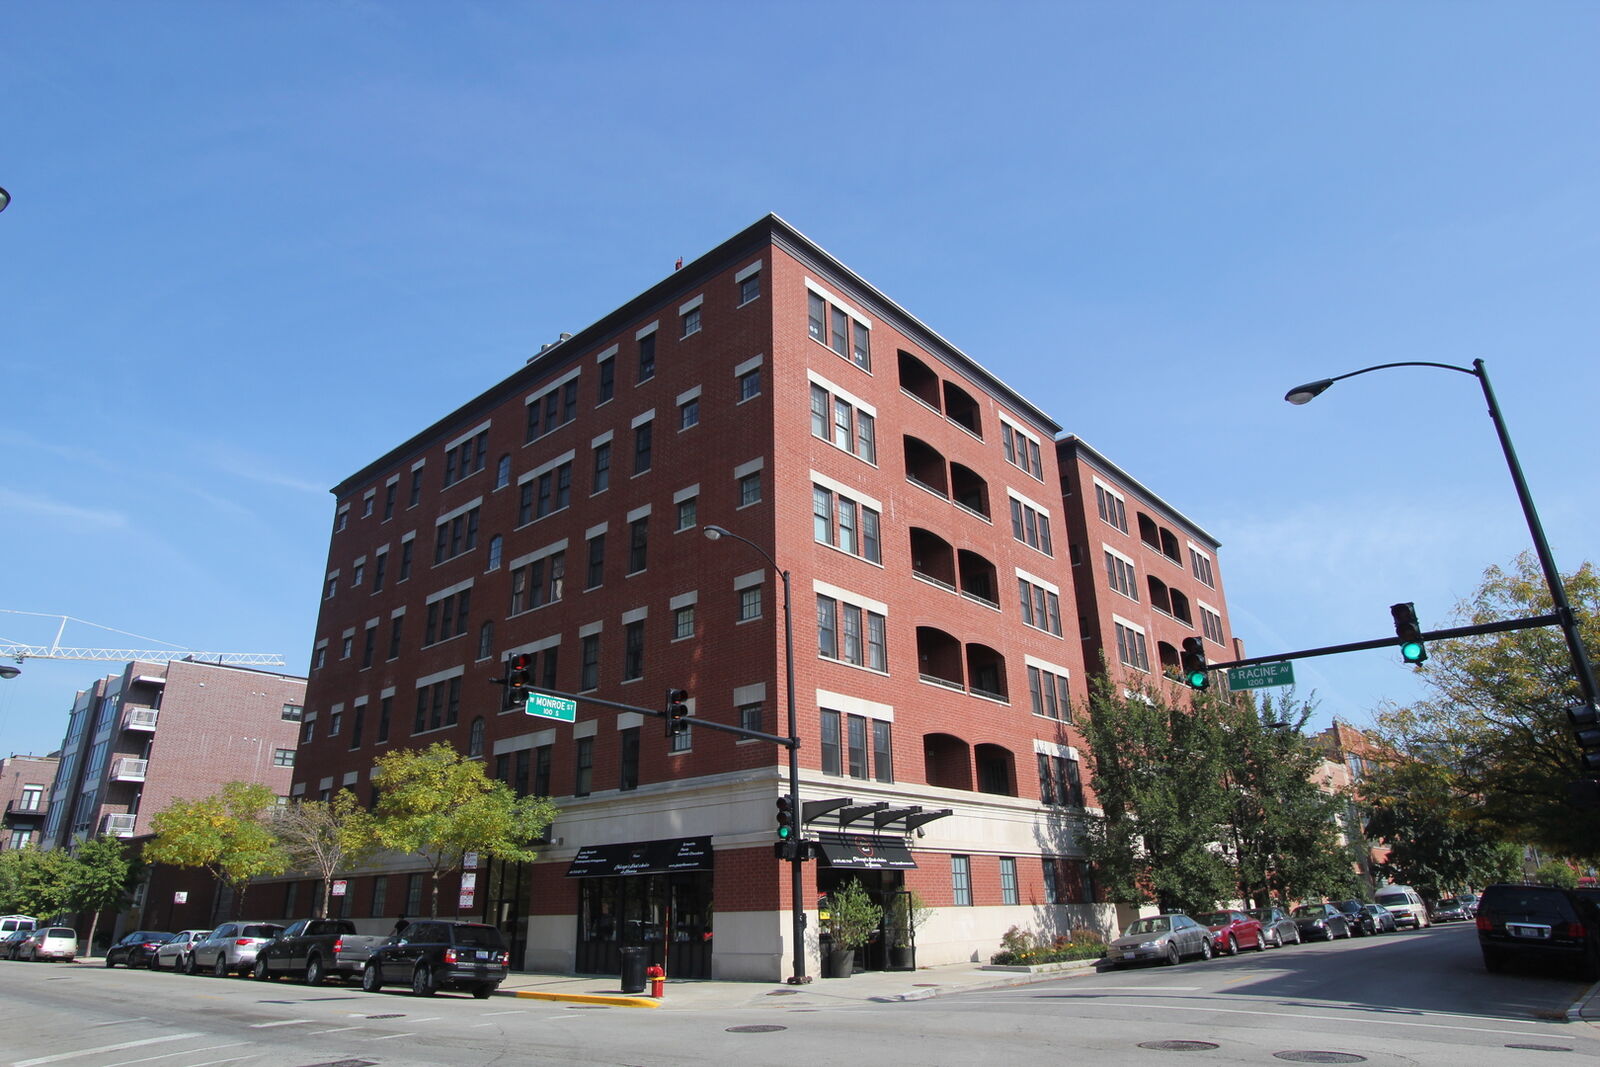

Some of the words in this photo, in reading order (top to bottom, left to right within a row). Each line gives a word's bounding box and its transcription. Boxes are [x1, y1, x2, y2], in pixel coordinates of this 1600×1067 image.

[1230, 672, 1236, 680] S
[1238, 666, 1278, 680] RACINE
[1247, 678, 1264, 687] 1200
[536, 696, 566, 711] MONROE
[566, 703, 574, 711] ST
[543, 707, 553, 716] 100
